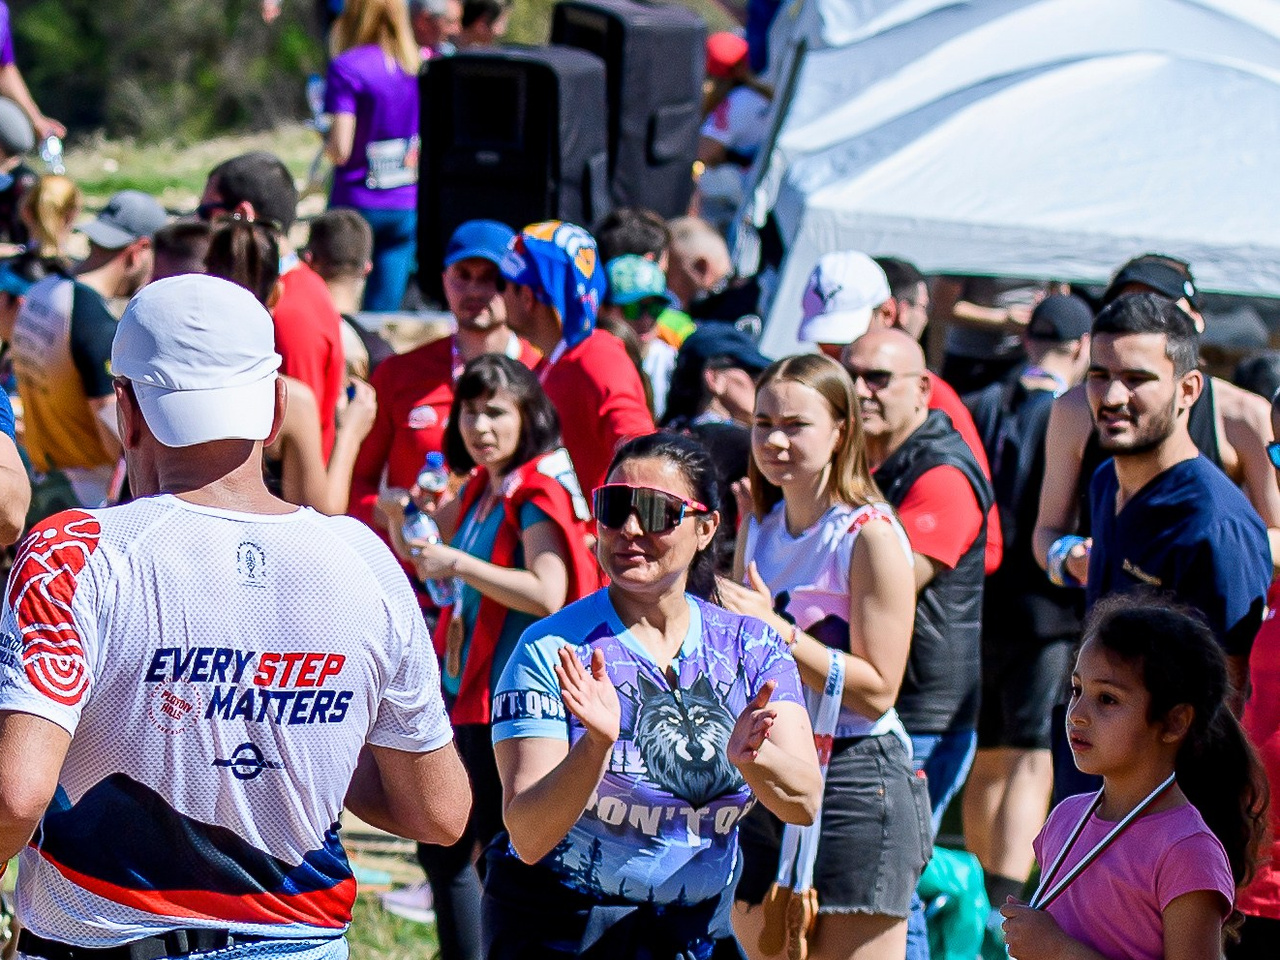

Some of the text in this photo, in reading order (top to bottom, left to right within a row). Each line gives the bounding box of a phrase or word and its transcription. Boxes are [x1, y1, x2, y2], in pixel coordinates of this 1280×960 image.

[144, 647, 346, 688] EVERY STEP
[204, 686, 354, 725] MATTERS
